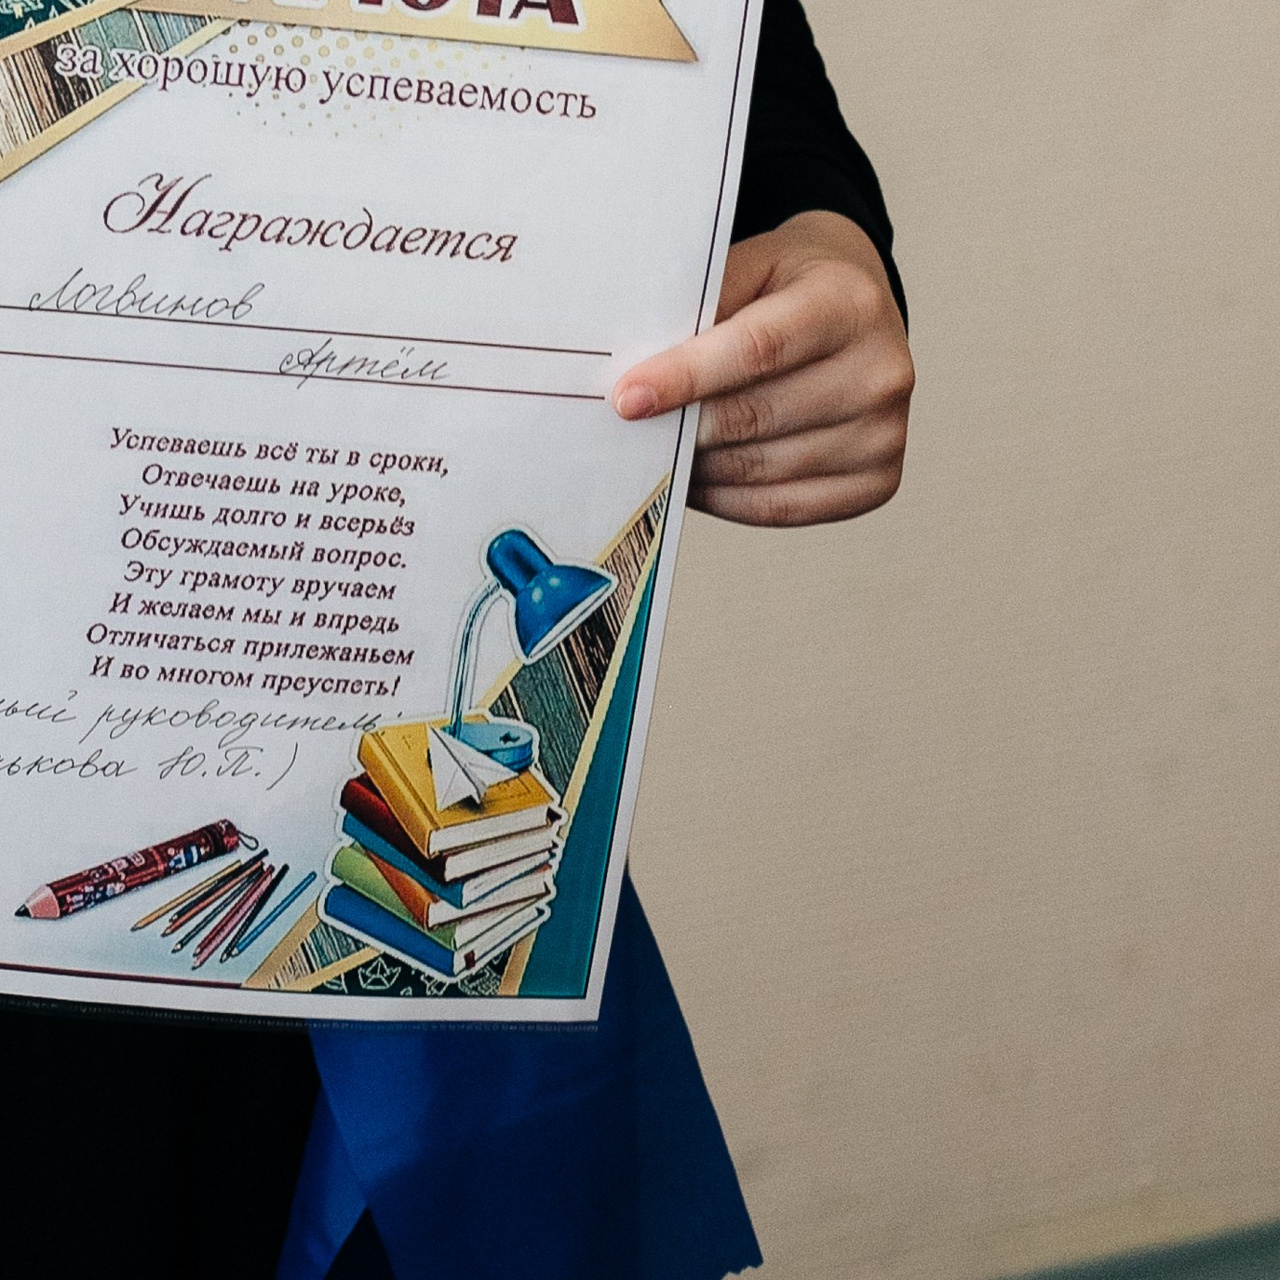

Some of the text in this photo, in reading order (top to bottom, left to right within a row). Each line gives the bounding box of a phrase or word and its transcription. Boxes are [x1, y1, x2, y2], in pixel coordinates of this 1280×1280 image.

[56, 43, 598, 120] за хорошую успеваемость
[102, 172, 519, 264] Награждается
[29, 267, 266, 321] Логвинов
[279, 337, 451, 391] Артём
[111, 428, 449, 478] Успеваешь всё ты в сроки,
[142, 464, 406, 508] Отвечаешь на уроке,
[119, 494, 415, 538] Учишь долго и всерьёз
[121, 528, 407, 571] Обсуждаемый вопрос.
[124, 561, 396, 601] Эту грамоту вручаем
[109, 593, 399, 634] И желаем мы и впредь
[86, 623, 414, 666] Отличаться прилежаньем
[90, 655, 401, 697] И во многом преуспеть!
